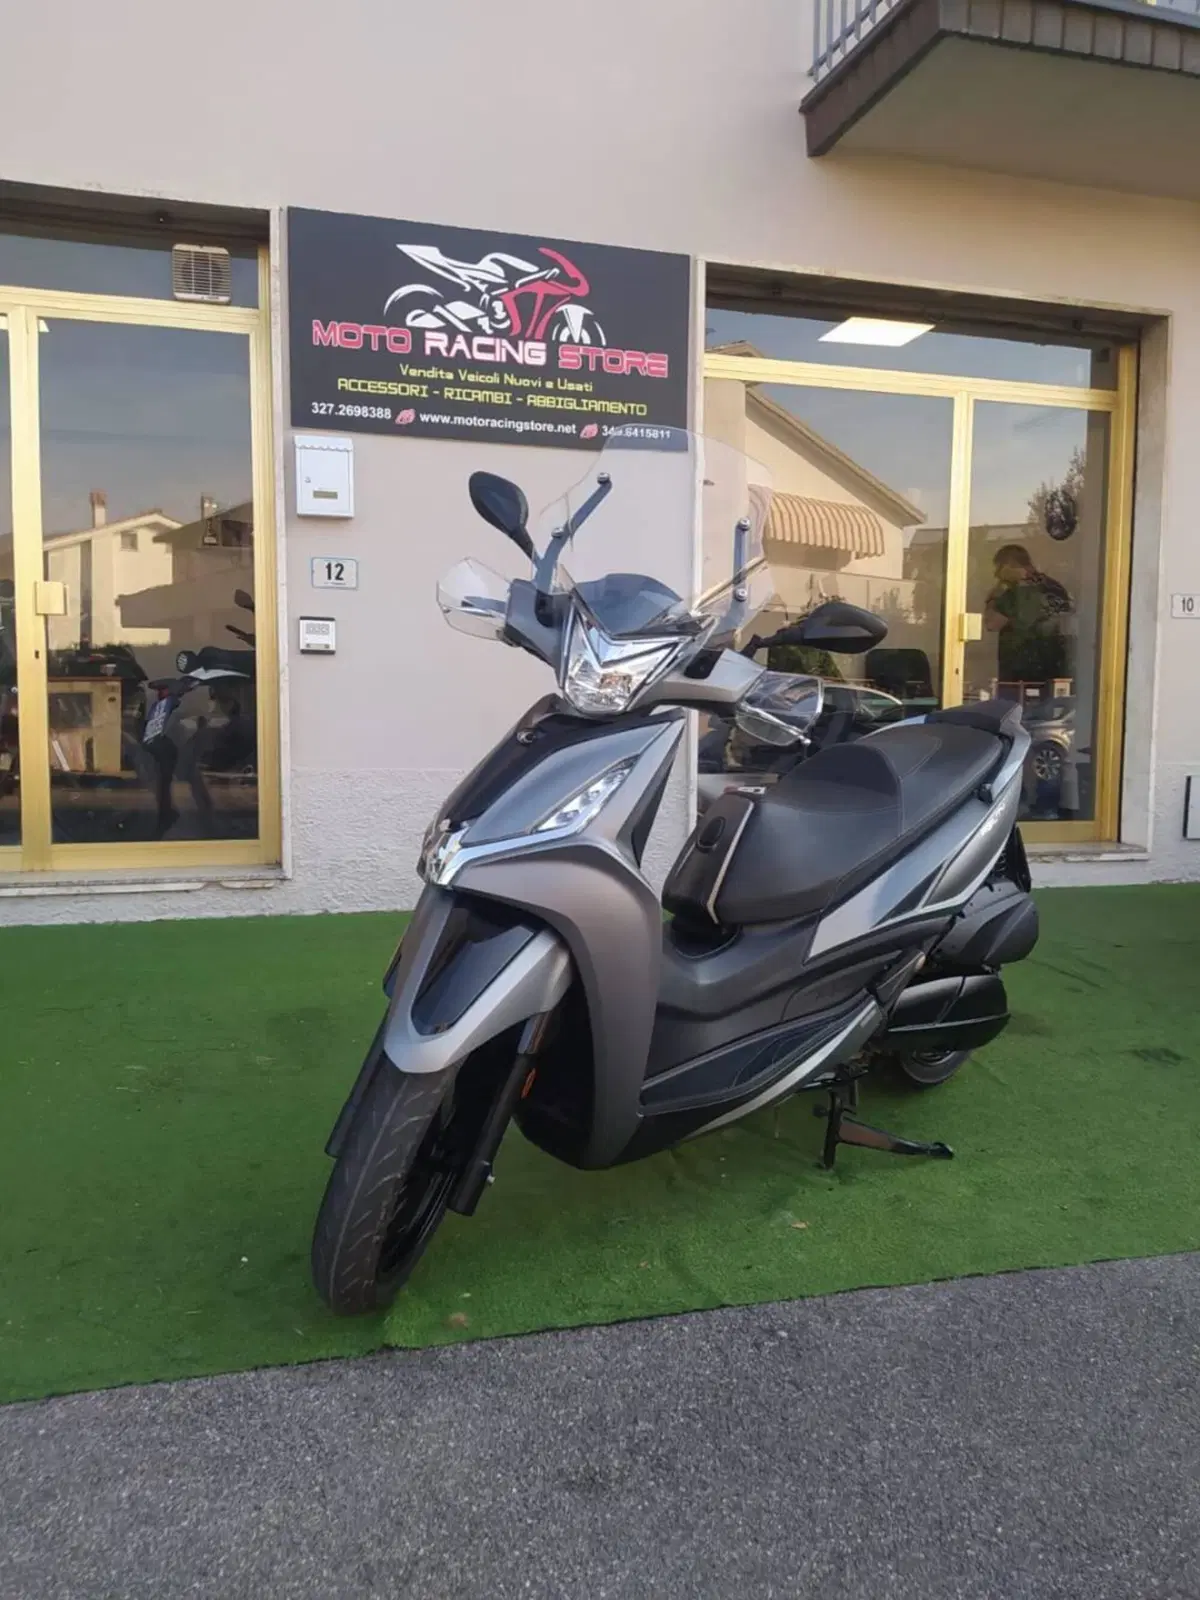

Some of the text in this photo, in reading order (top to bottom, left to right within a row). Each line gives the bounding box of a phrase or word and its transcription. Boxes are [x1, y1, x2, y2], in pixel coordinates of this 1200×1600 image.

[312, 320, 668, 378] MOTO RACING STORE
[399, 363, 593, 393] Vendita Veicoli Nuovi e Usati
[338, 378, 429, 397] ACCESSORI
[443, 387, 512, 405] RICAMBI
[527, 394, 647, 416] ABBIGLIAMENTO
[311, 402, 392, 420] 327.2698388
[419, 414, 576, 434] www.motoracingstore.net
[325, 562, 344, 581] 12
[1182, 597, 1194, 612] 10
